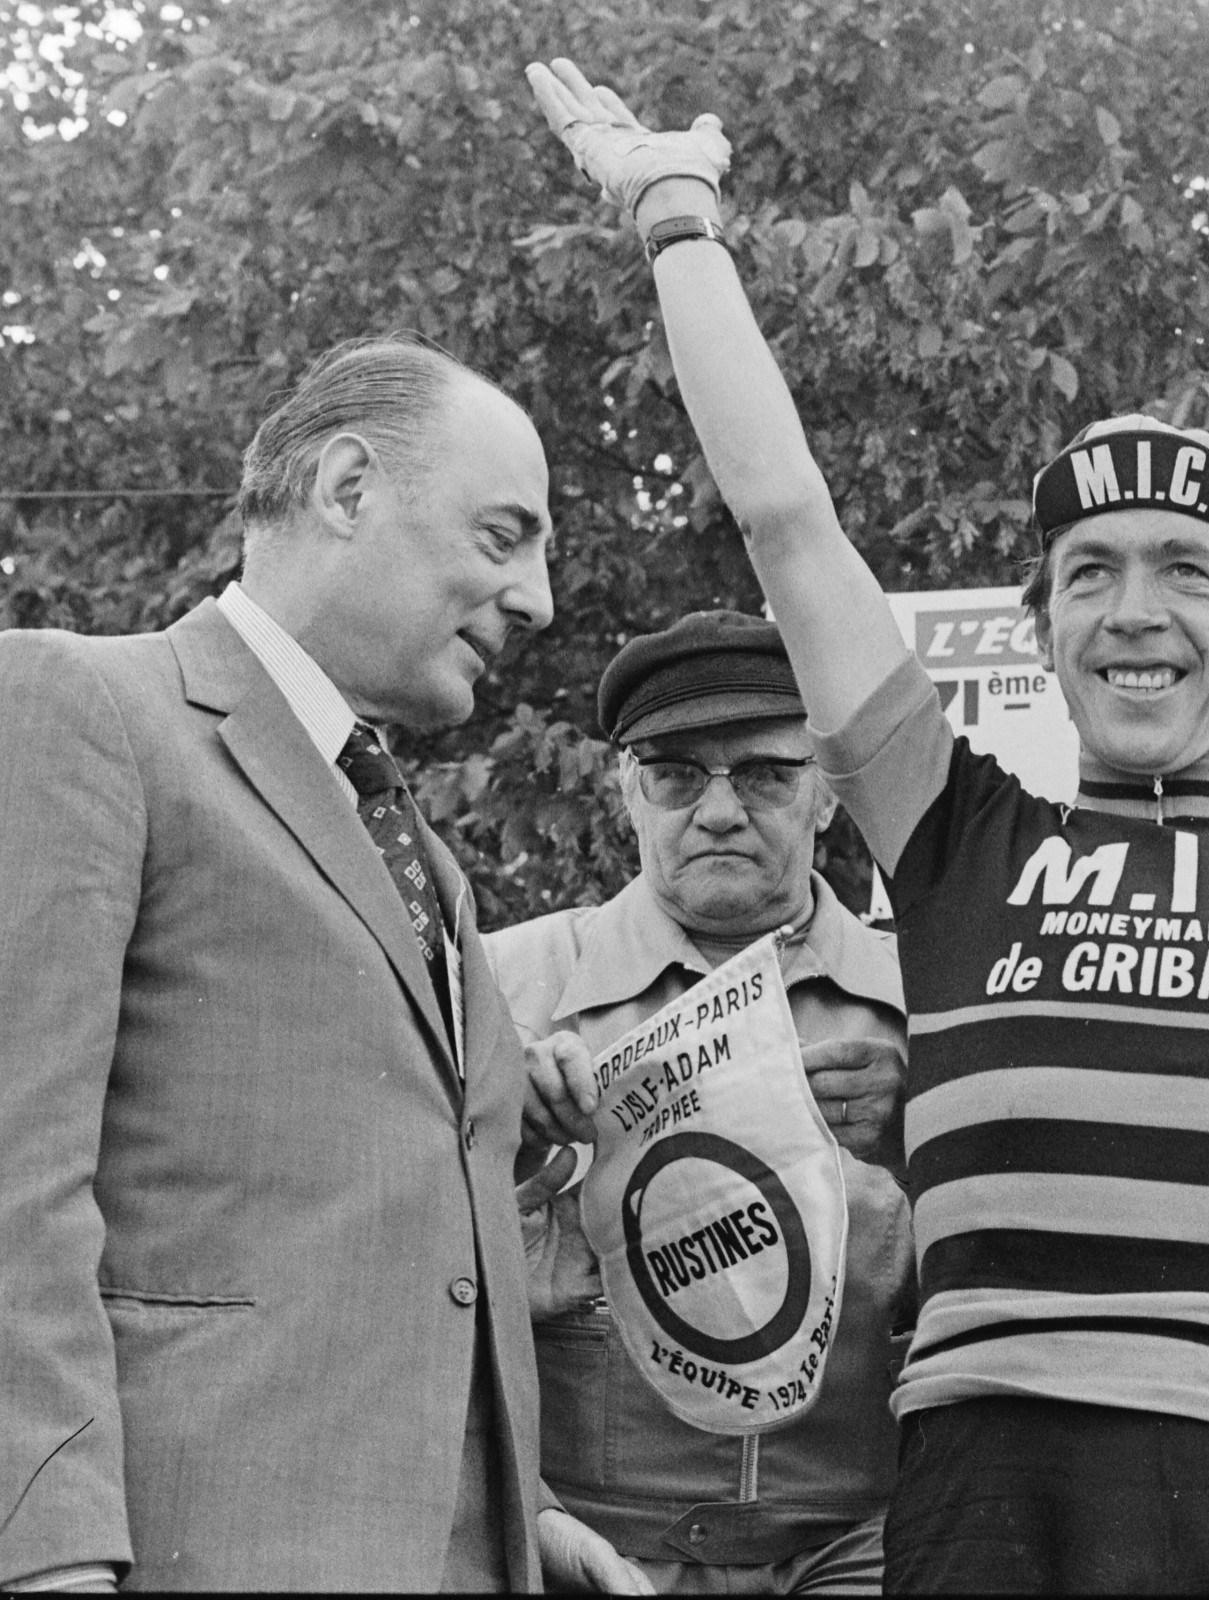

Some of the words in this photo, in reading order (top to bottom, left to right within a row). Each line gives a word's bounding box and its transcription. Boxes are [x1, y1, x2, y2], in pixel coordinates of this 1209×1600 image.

[1070, 441, 1208, 513] M.I.C.
[986, 942, 1043, 995] de
[646, 1202, 778, 1297] RUSTINES
[768, 1380, 806, 1410] 1974
[800, 1353, 818, 1383] Le
